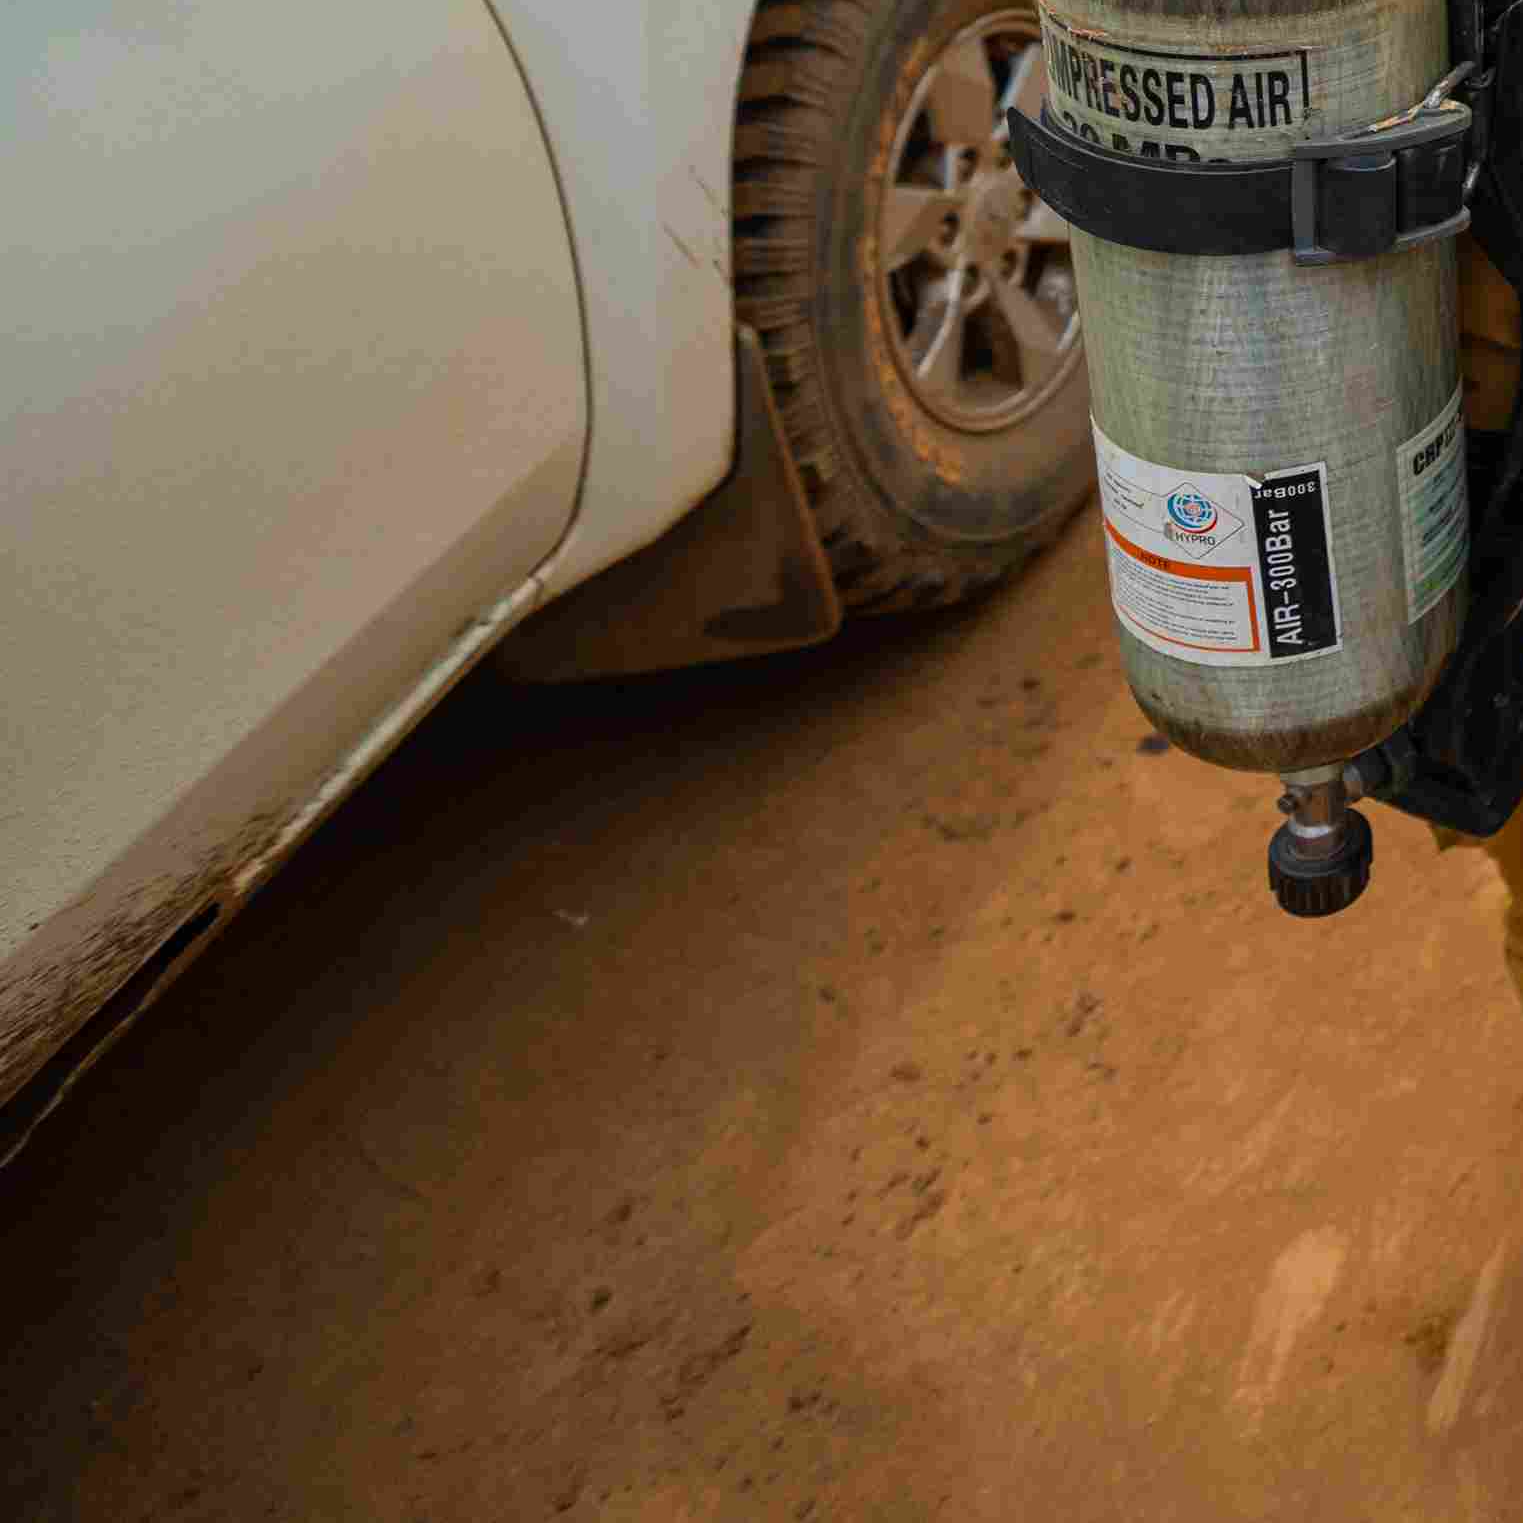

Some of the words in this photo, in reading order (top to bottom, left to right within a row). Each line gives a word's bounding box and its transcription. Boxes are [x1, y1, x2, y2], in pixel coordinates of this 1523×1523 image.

[1228, 70, 1294, 129] AIR
[1254, 481, 1317, 501] 300Bar
[1174, 532, 1216, 547] HYPRO
[1265, 509, 1305, 645] AIR-300Bar
